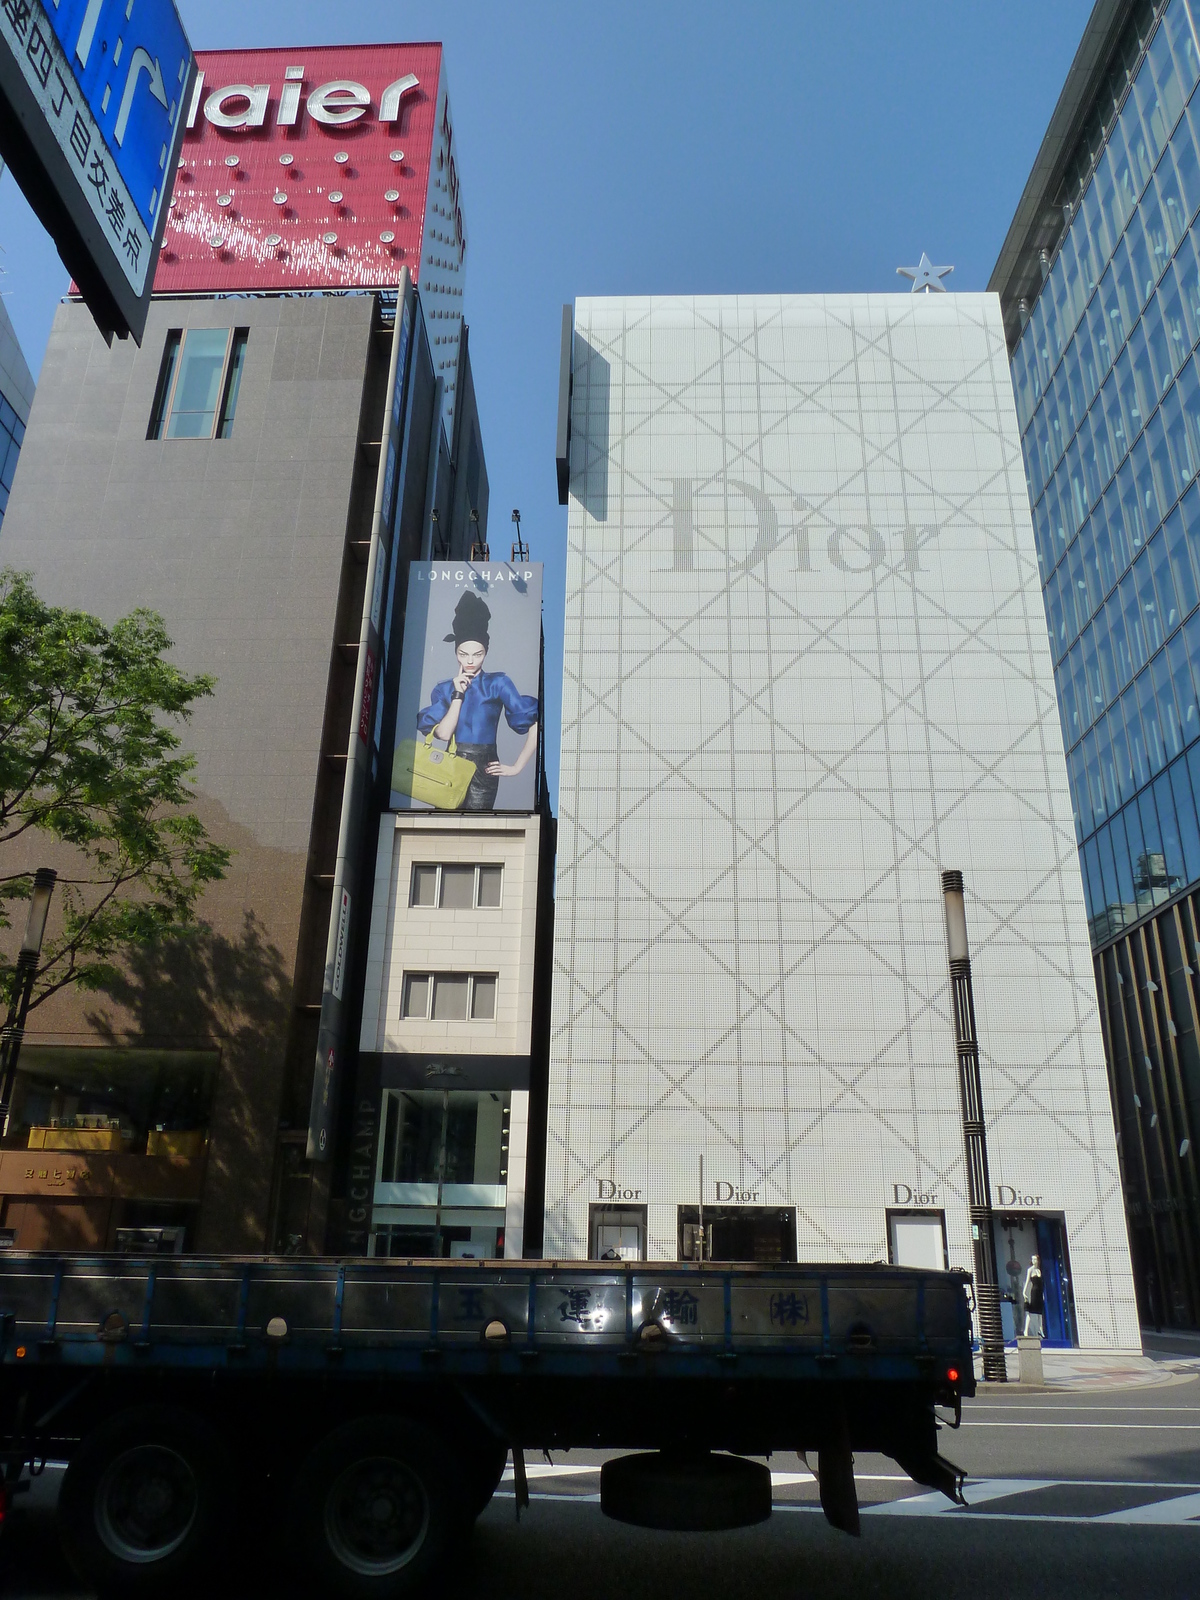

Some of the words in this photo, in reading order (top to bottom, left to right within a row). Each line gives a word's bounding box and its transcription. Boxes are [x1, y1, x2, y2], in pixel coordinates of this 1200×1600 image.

[649, 477, 941, 573] Dior
[418, 570, 533, 581] LONGCHAMP
[597, 1179, 642, 1200] Dior
[714, 1181, 759, 1202] Dior
[891, 1183, 938, 1205] Dior
[995, 1185, 1042, 1206] Dior
